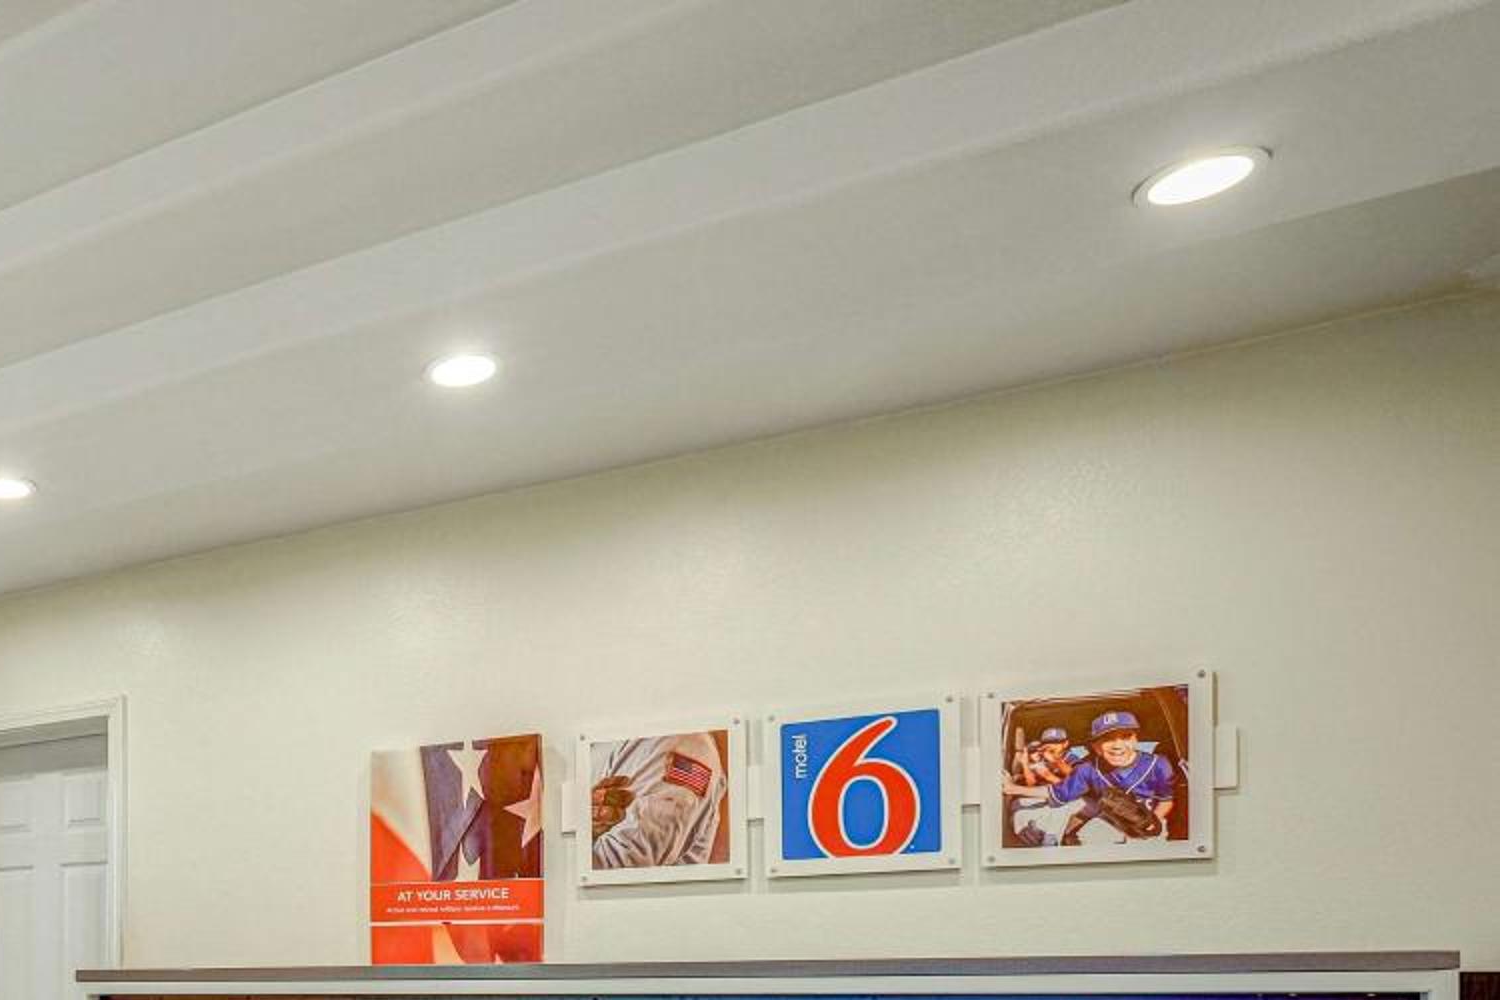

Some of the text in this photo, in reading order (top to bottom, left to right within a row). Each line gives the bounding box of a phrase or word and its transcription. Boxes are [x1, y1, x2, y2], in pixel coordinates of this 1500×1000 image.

[791, 735, 807, 779] motel
[808, 716, 921, 858] 6
[397, 887, 510, 902] AT YOUR SERVICE
